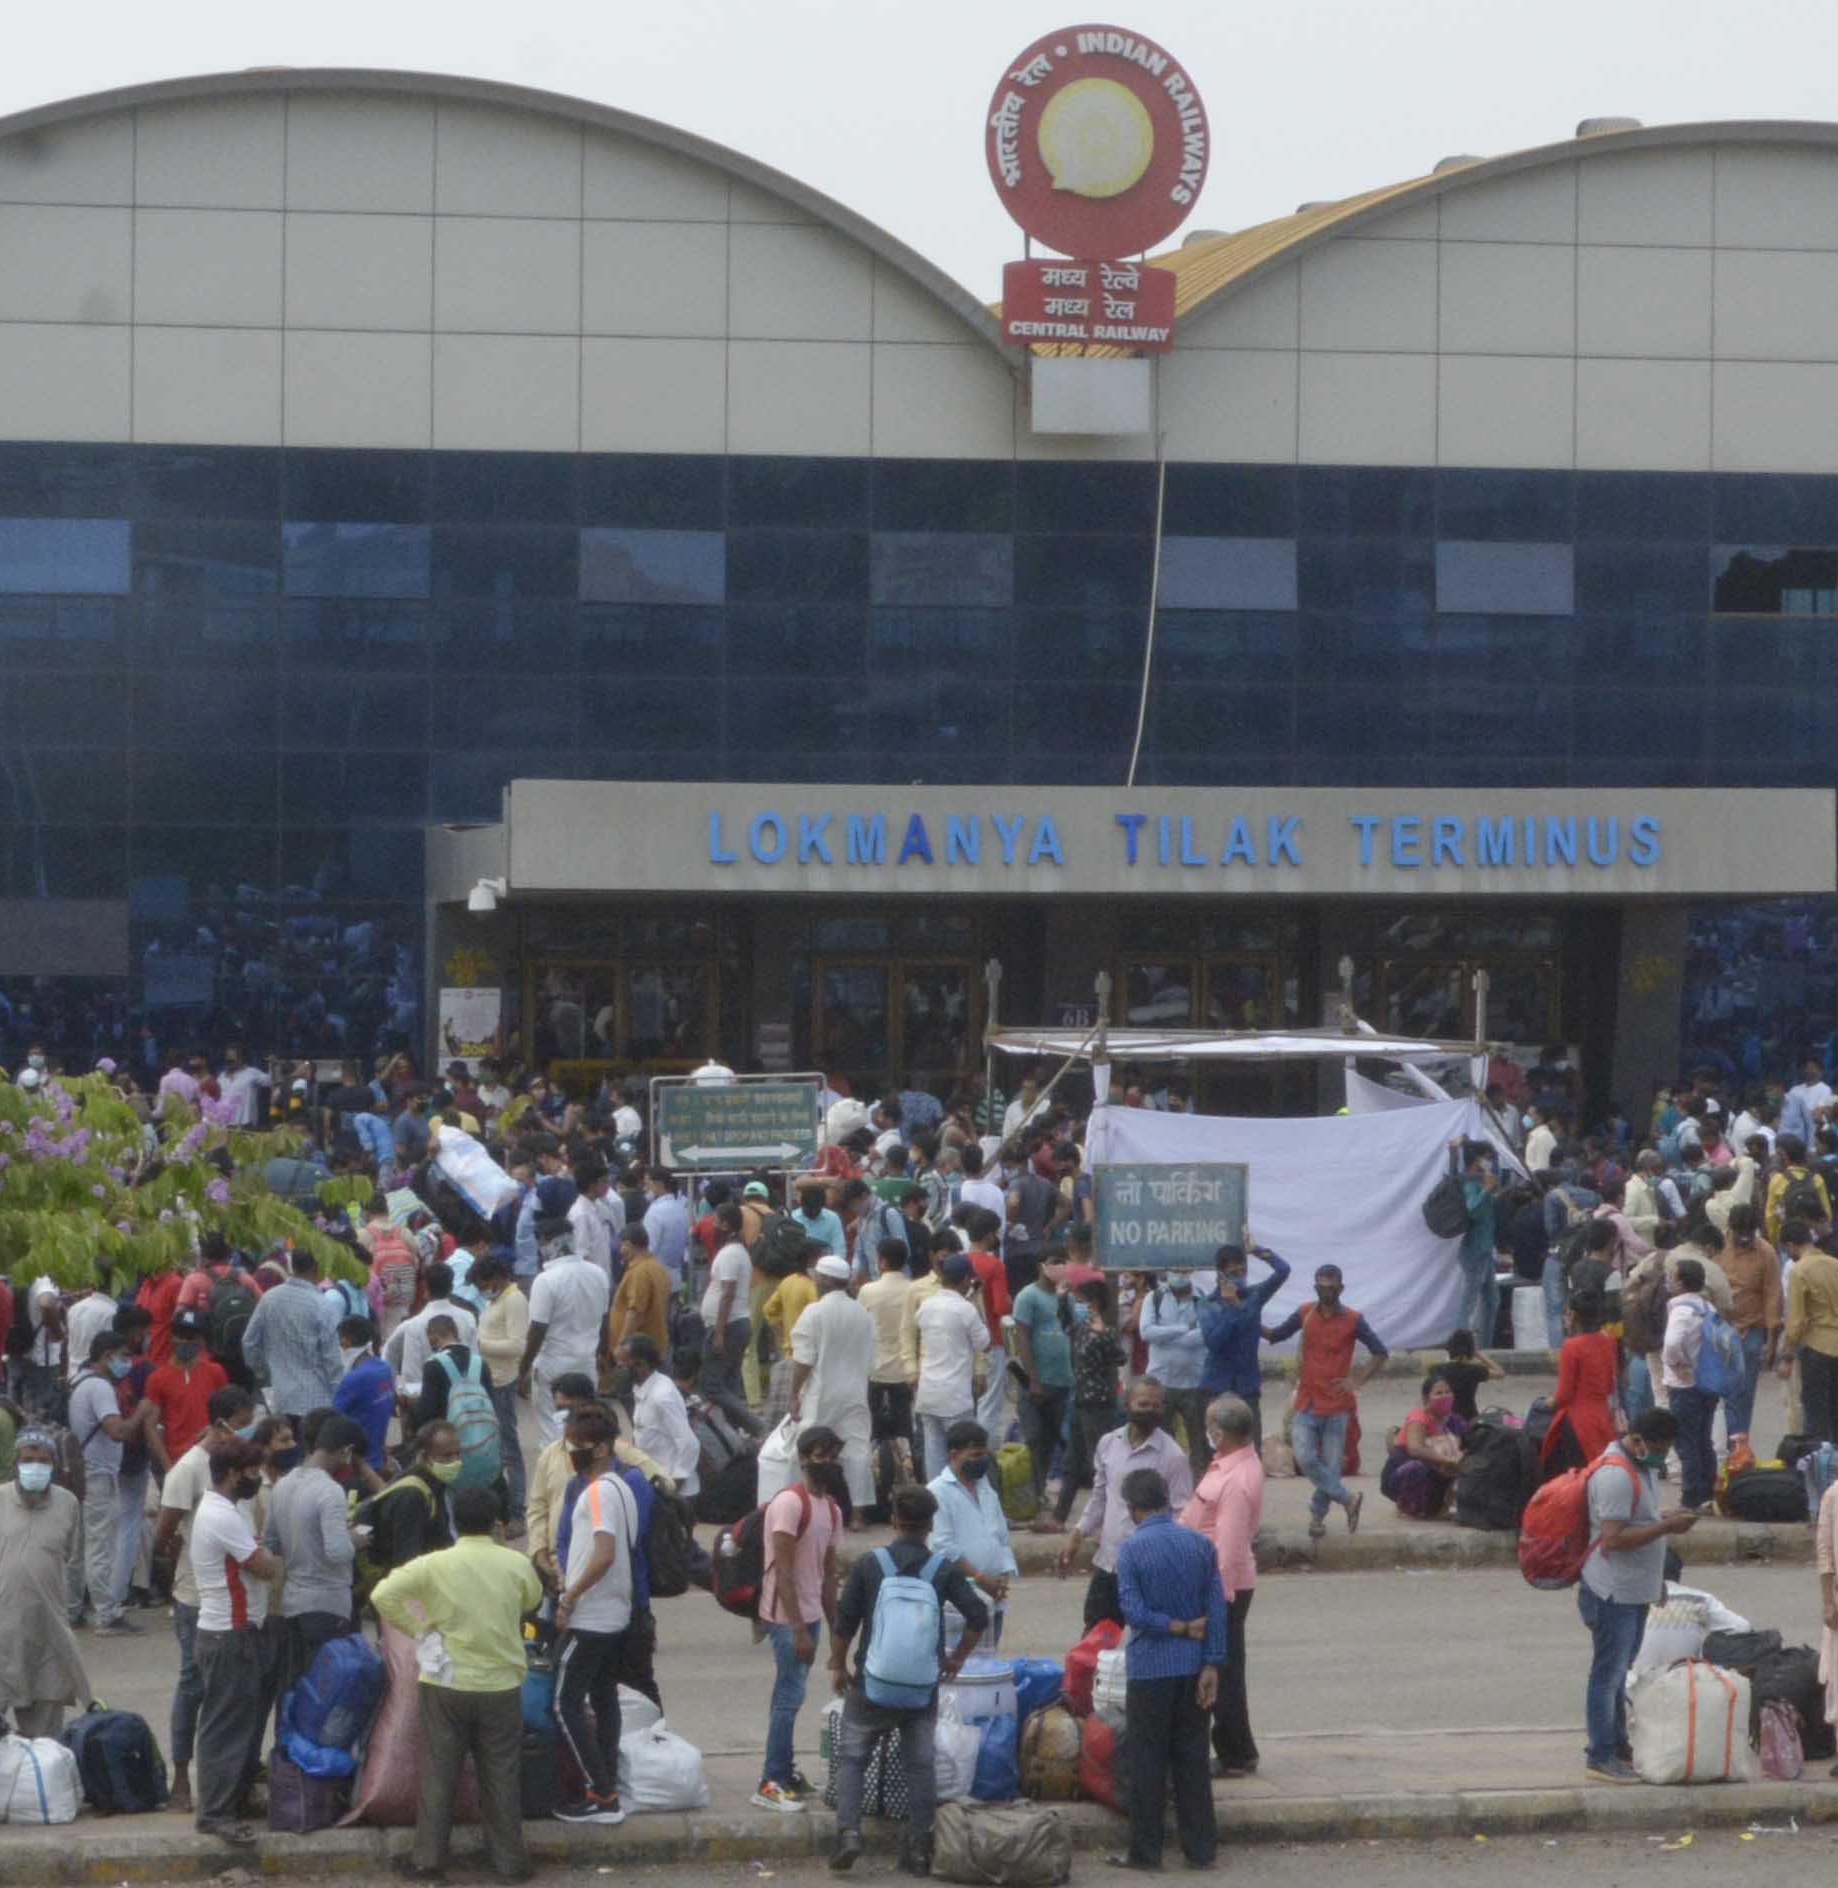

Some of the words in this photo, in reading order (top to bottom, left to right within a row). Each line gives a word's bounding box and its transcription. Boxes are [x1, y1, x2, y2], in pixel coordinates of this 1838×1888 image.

[991, 93, 1026, 188] भारतीय
[1009, 53, 1054, 88] रेल
[1077, 32, 1168, 76] INDIAN
[1162, 72, 1205, 205] RAILWAYS
[1041, 266, 1088, 287] मध्य
[1100, 264, 1141, 291] रेल्वे
[1043, 299, 1089, 317] मध्य
[1104, 295, 1134, 320] रेल
[1009, 320, 1088, 339] CENTRAL
[1093, 324, 1170, 343] RAILWAY
[709, 811, 1065, 866] LOKMANYA
[1116, 814, 1303, 866] TILAK
[1352, 815, 1662, 866] TERMINUS
[1062, 1008, 1090, 1026] 6B
[1110, 1221, 1141, 1245] NO
[1146, 1220, 1228, 1245] PARKING
